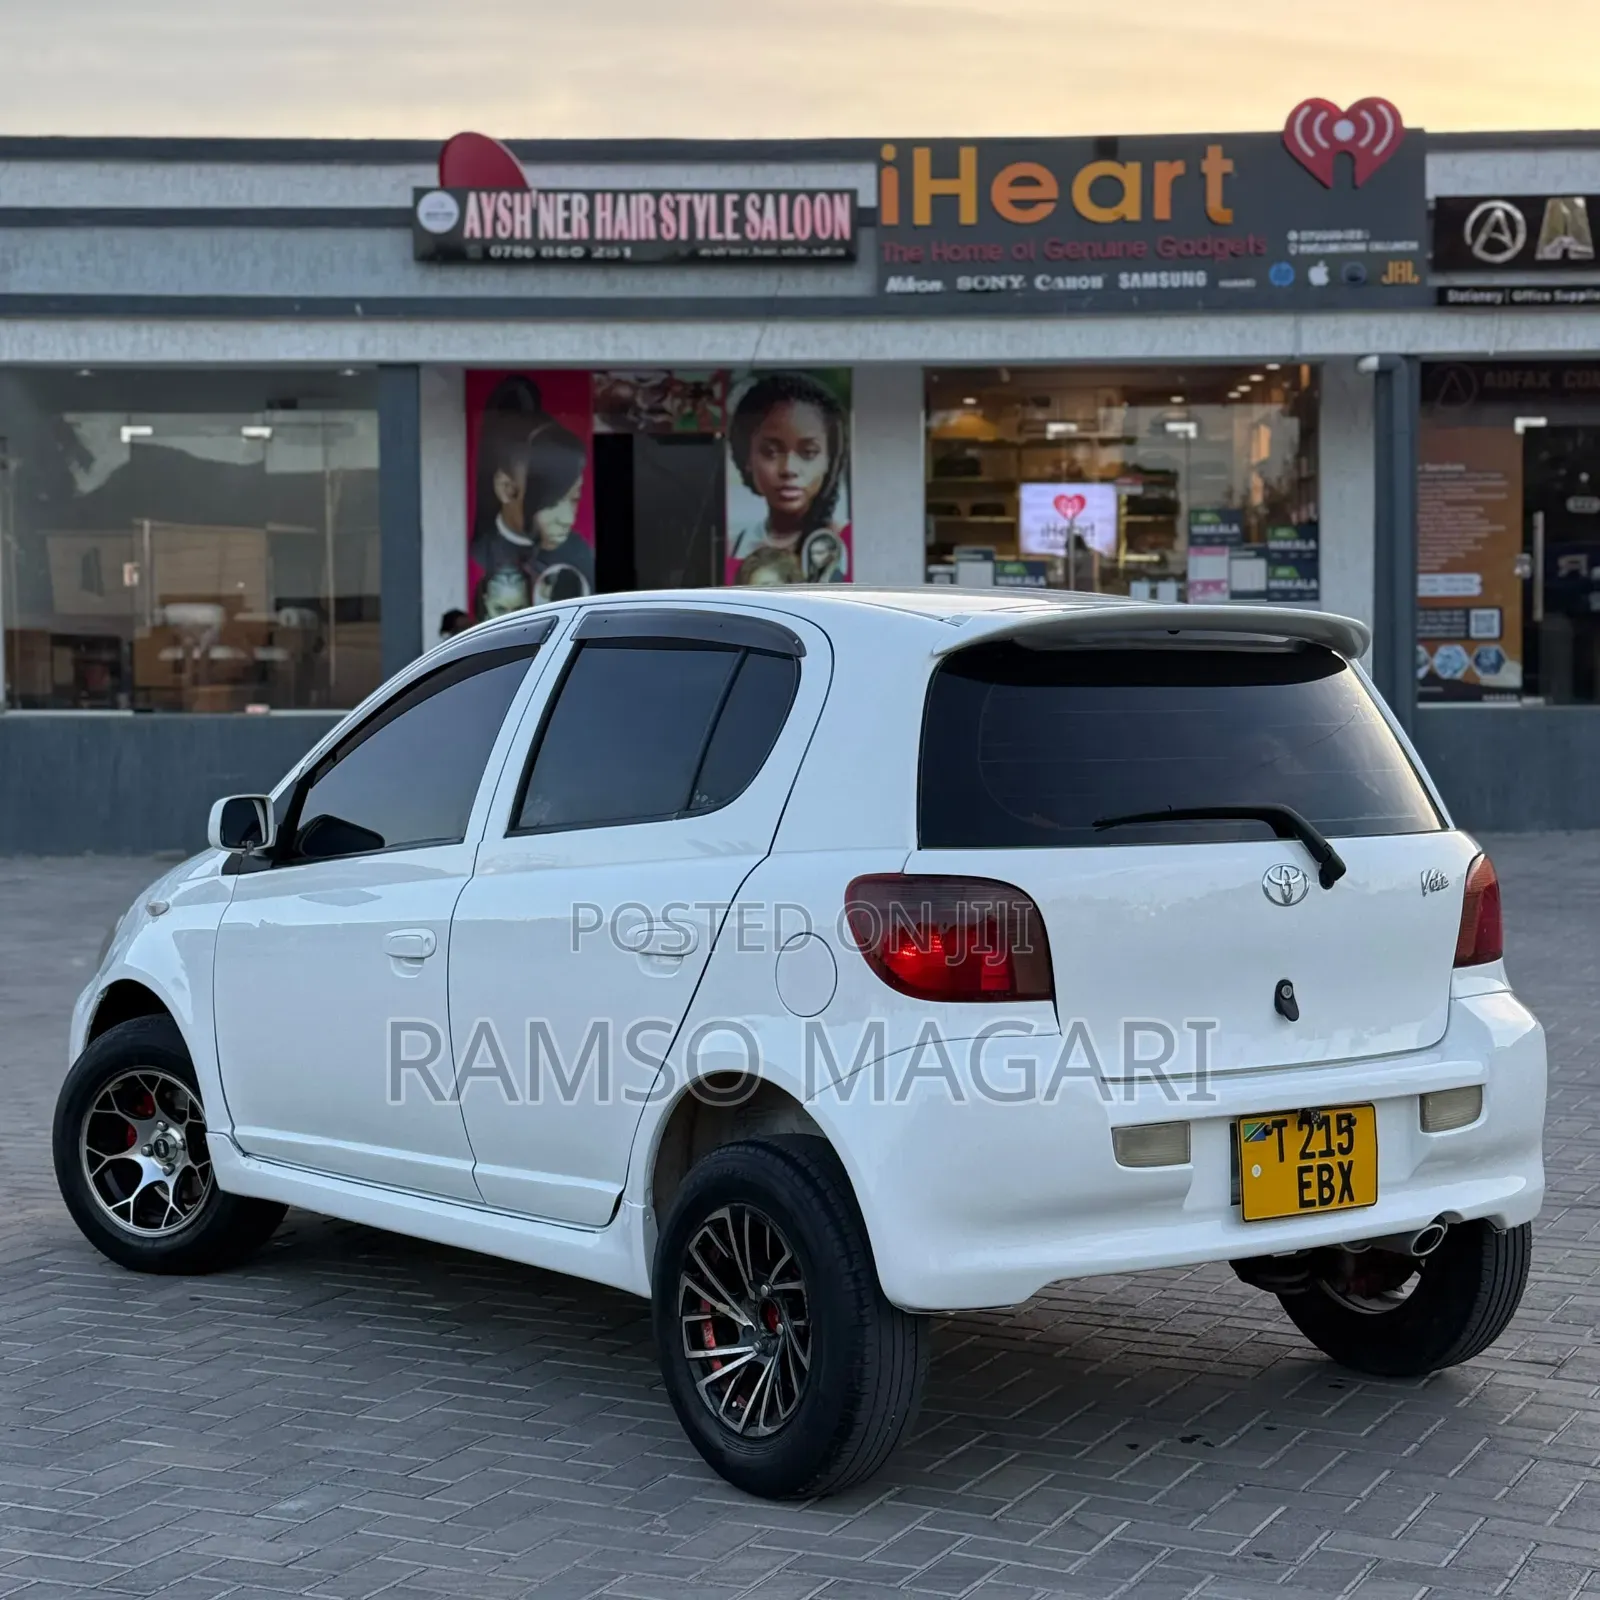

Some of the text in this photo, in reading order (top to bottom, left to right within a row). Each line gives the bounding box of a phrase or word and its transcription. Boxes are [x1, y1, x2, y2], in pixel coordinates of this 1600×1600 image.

[879, 143, 1236, 226] iHeart
[464, 190, 852, 242] AYSH'NER HAIR STYLE SALOON
[881, 242, 924, 262] The
[931, 240, 1004, 262] Home
[1043, 236, 1147, 262] Genuine
[1155, 233, 1266, 262] Gadgets
[956, 274, 1026, 291] SONY
[1034, 273, 1104, 291] Canon
[1118, 270, 1208, 289] SAMSUNG
[1511, 289, 1552, 302] Office
[1271, 1112, 1356, 1163] T 215
[1296, 1159, 1356, 1210] EBX
